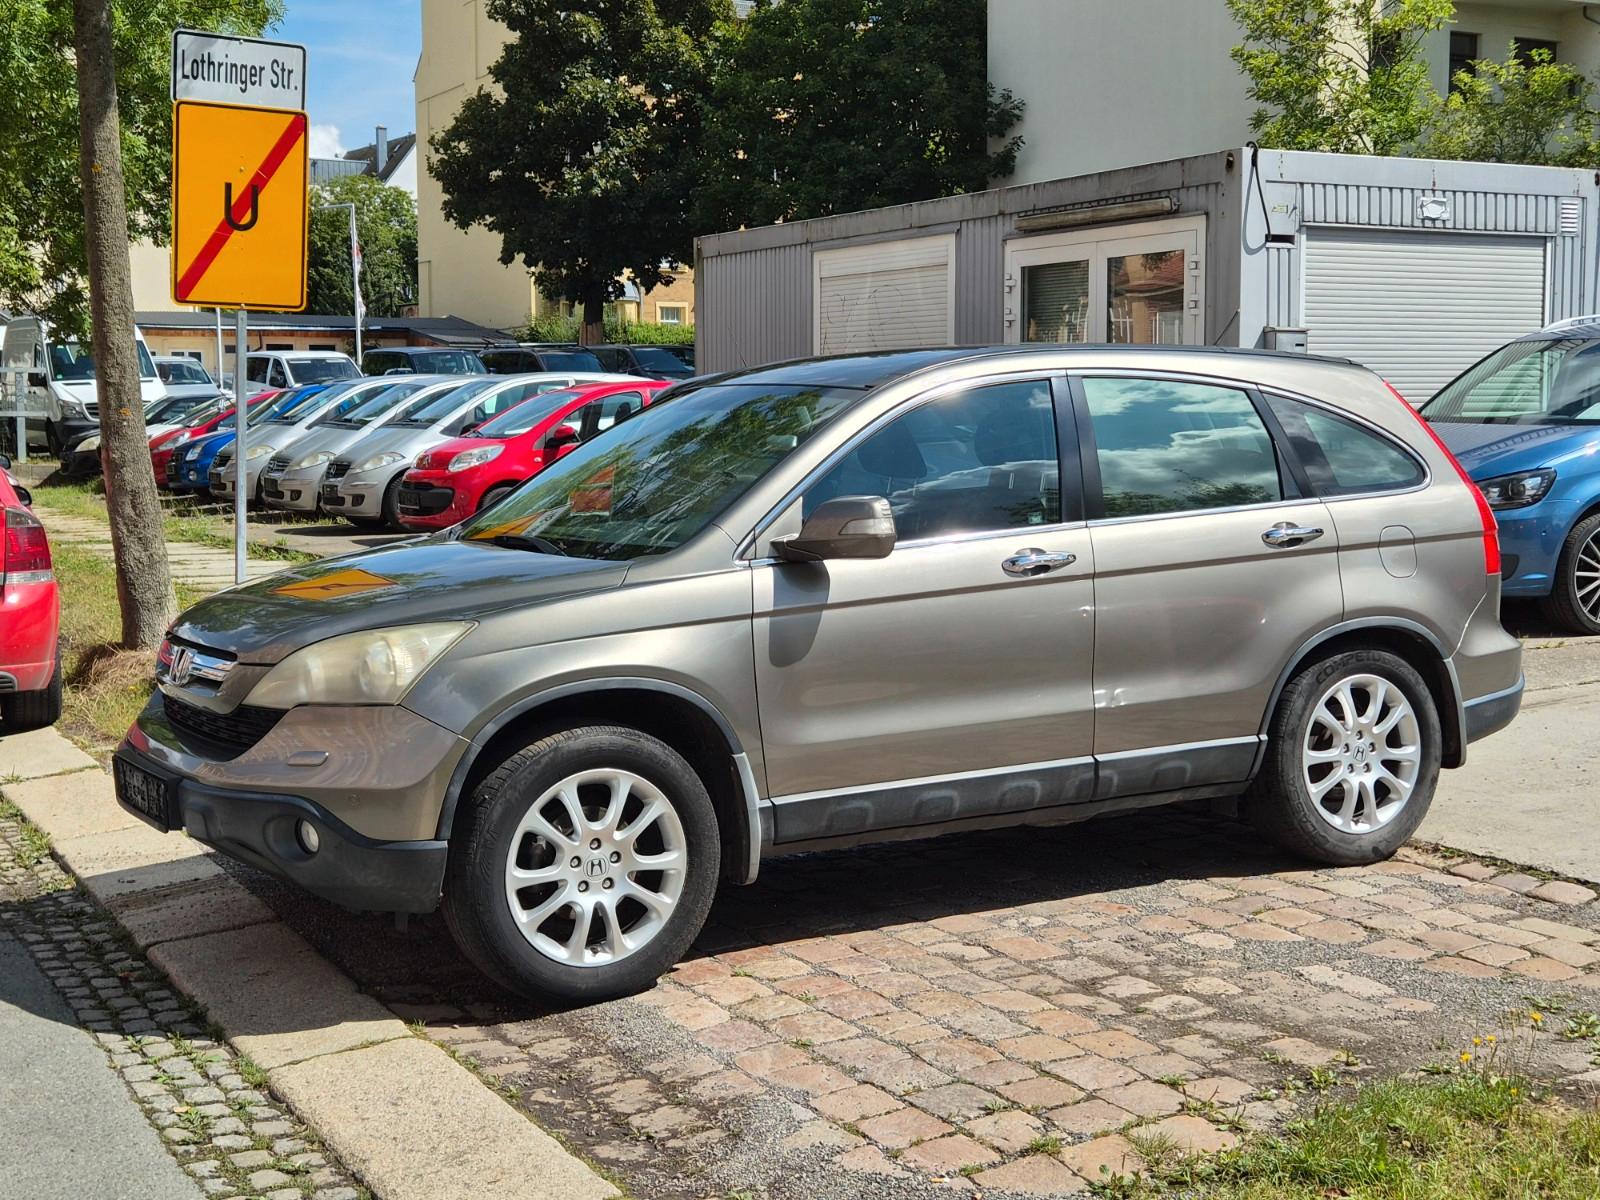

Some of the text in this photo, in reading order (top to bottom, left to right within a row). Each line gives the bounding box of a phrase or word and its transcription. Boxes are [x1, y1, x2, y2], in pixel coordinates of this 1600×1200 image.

[181, 49, 298, 93] Lothringer Str.
[224, 182, 258, 232] U
